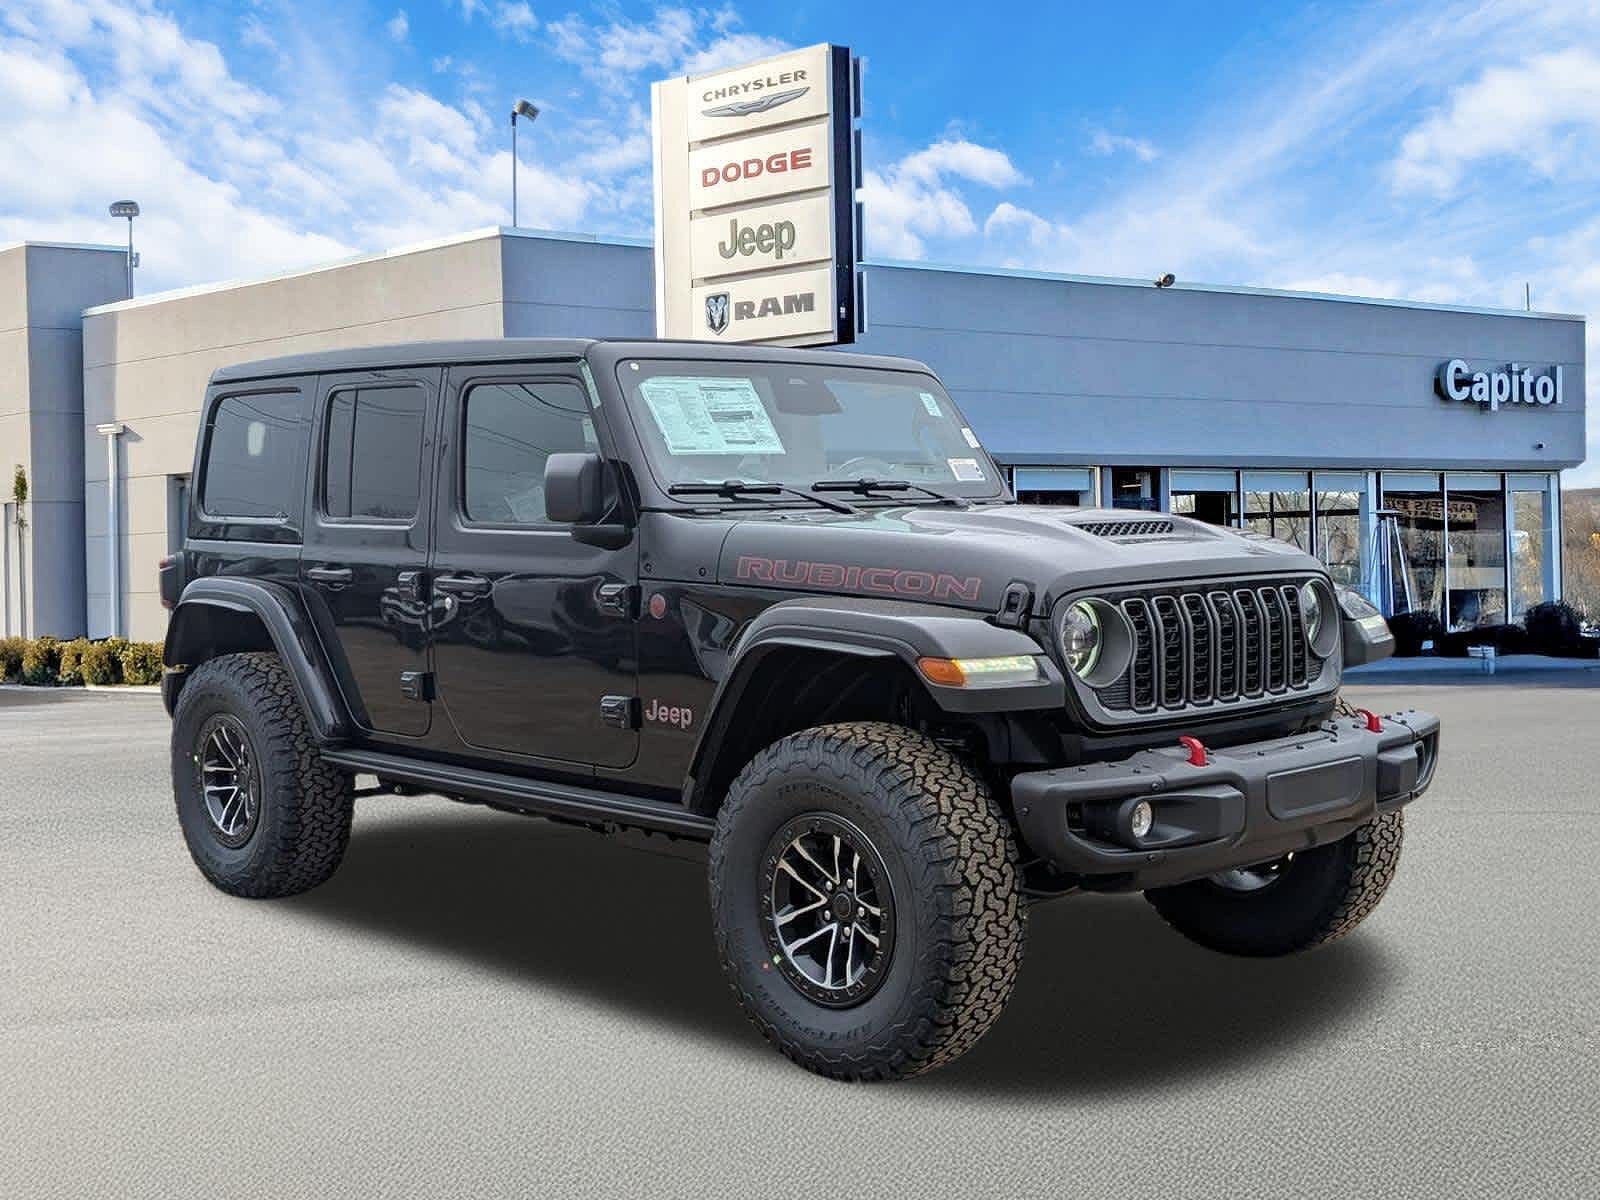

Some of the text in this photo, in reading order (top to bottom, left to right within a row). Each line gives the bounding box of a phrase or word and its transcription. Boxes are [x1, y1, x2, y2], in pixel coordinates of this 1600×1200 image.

[702, 69, 808, 103] CHRYSLER
[702, 147, 812, 188] DODGE
[718, 218, 796, 259] Jeep
[734, 292, 815, 321] RAM
[1445, 358, 1563, 411] Capitol
[736, 555, 982, 601] RUBICON
[644, 699, 693, 729] Jeep
